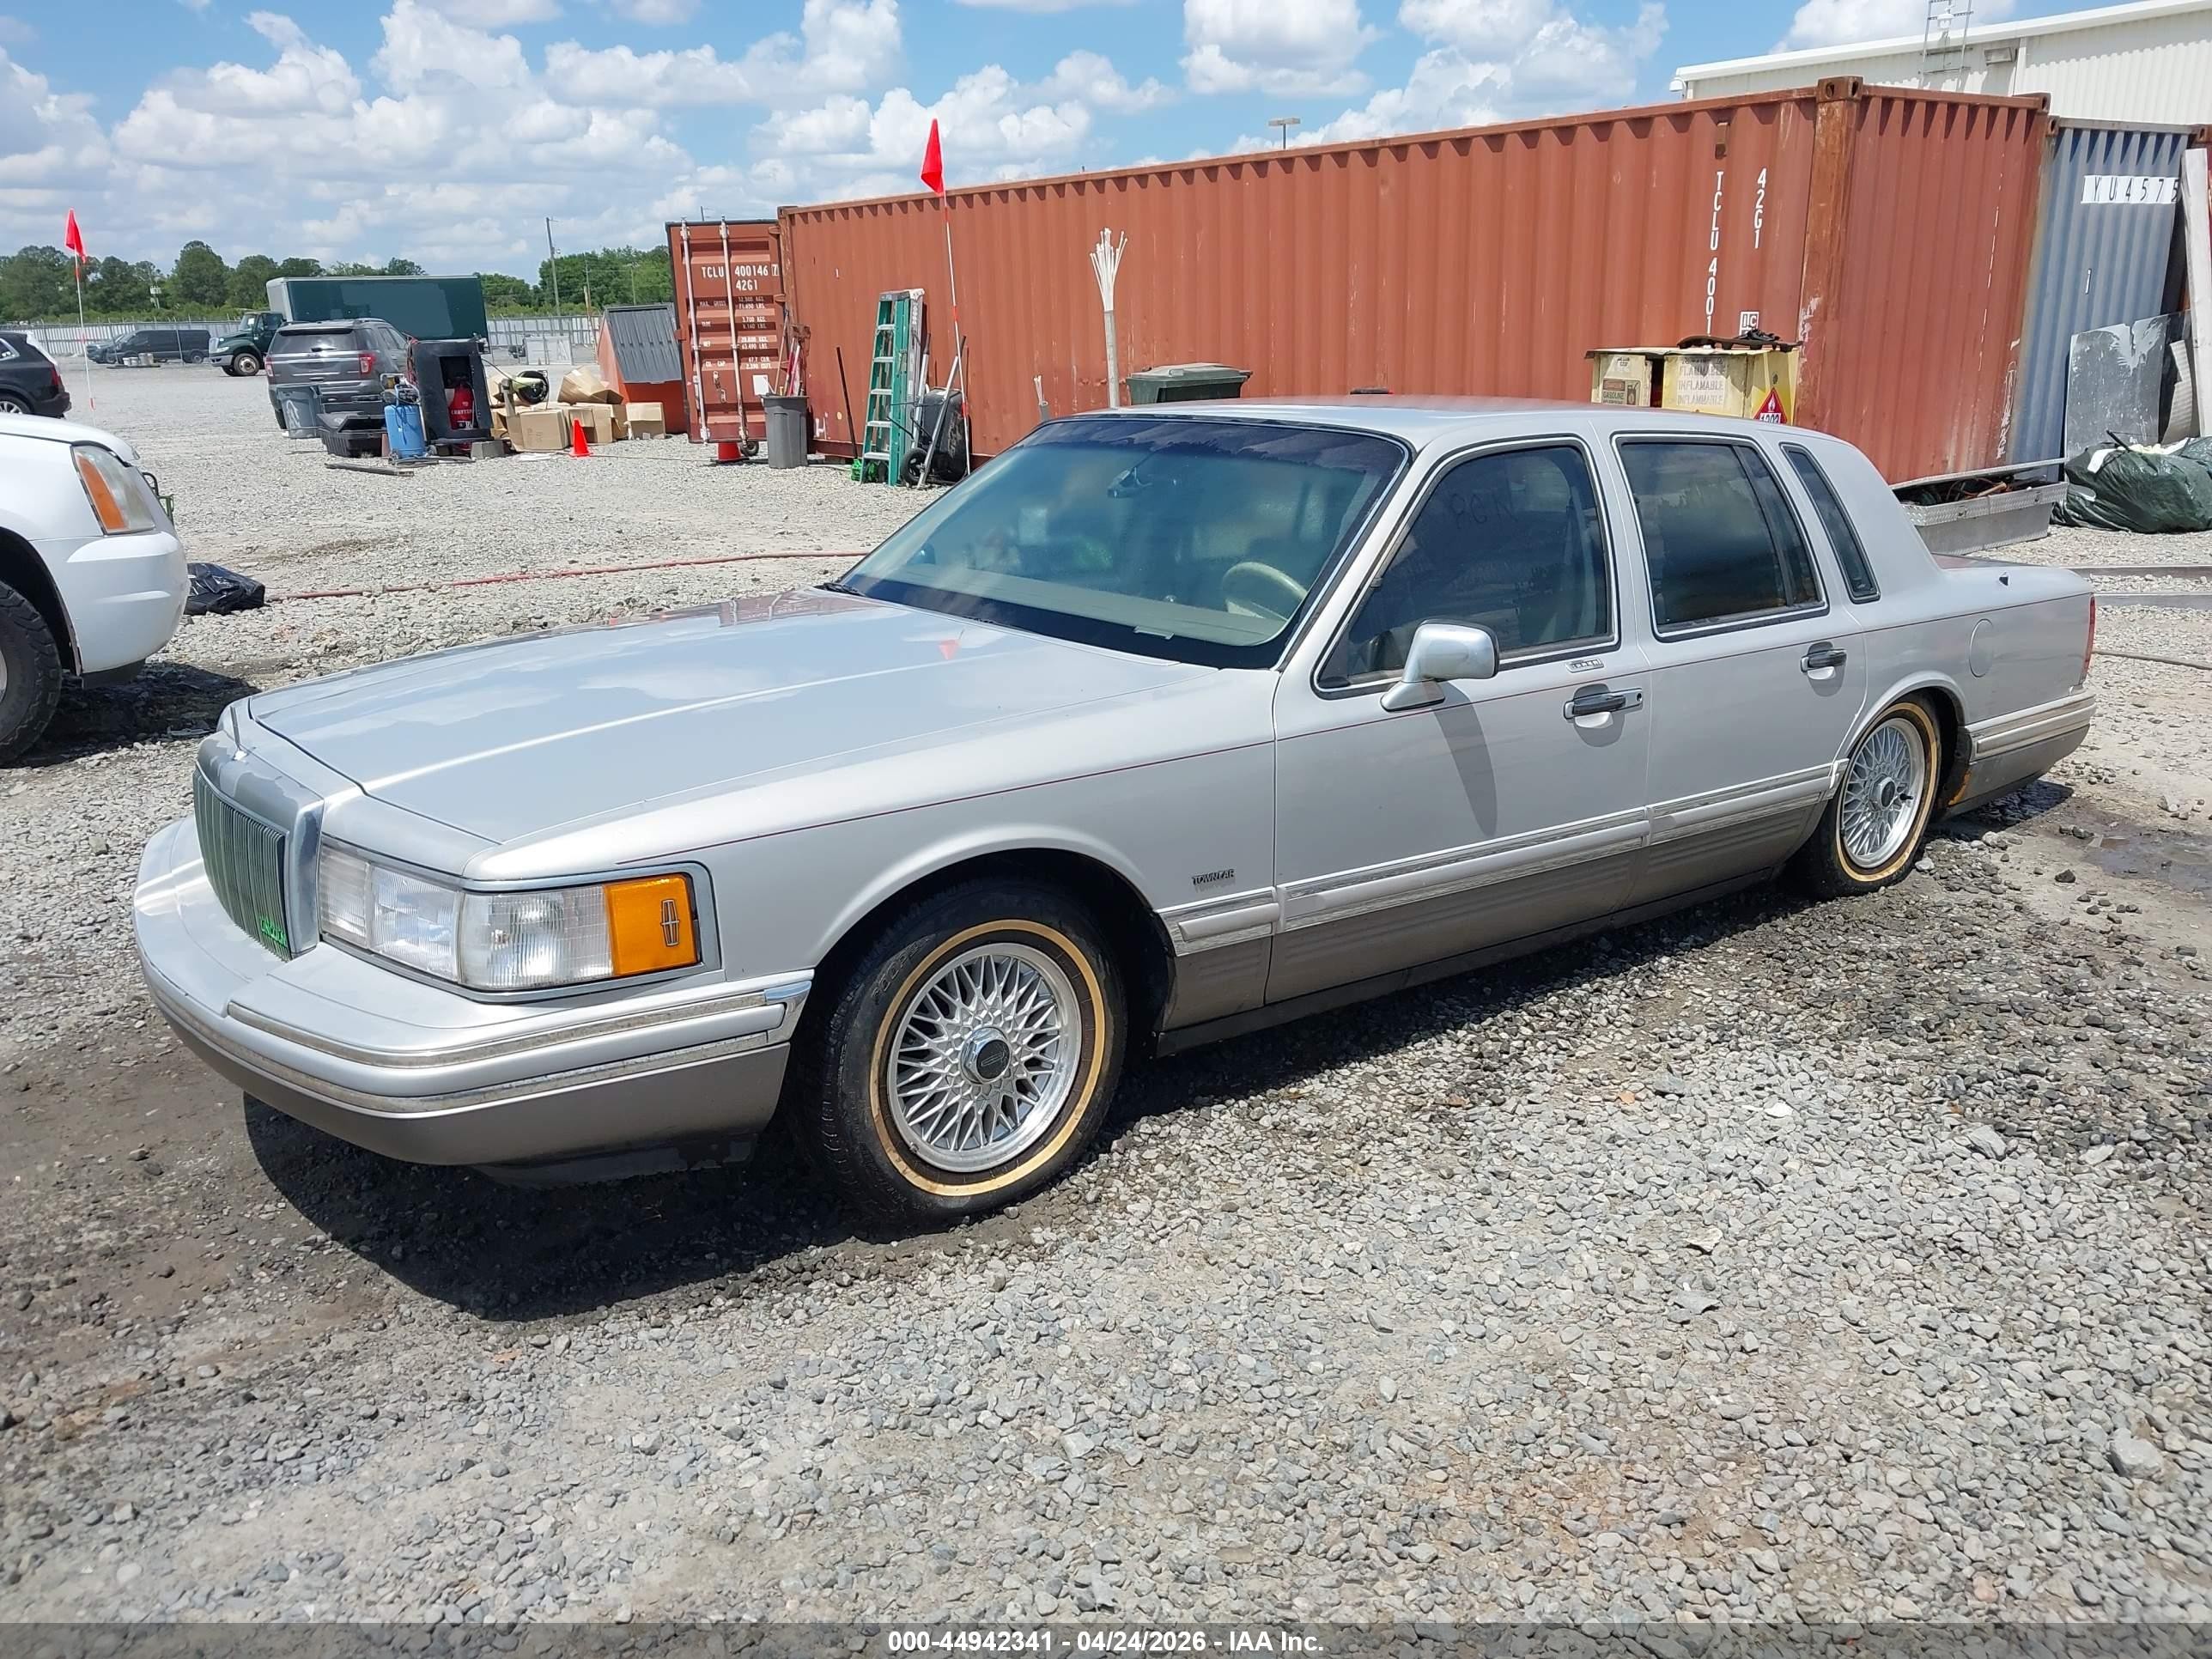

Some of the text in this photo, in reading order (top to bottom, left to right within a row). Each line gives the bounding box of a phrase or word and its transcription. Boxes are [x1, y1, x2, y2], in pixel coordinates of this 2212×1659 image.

[1710, 171, 1724, 251] TCLU
[1753, 168, 1767, 249] 42G1
[701, 266, 725, 278] TCLU
[734, 264, 769, 276] 400146
[736, 279, 758, 290] 42G1
